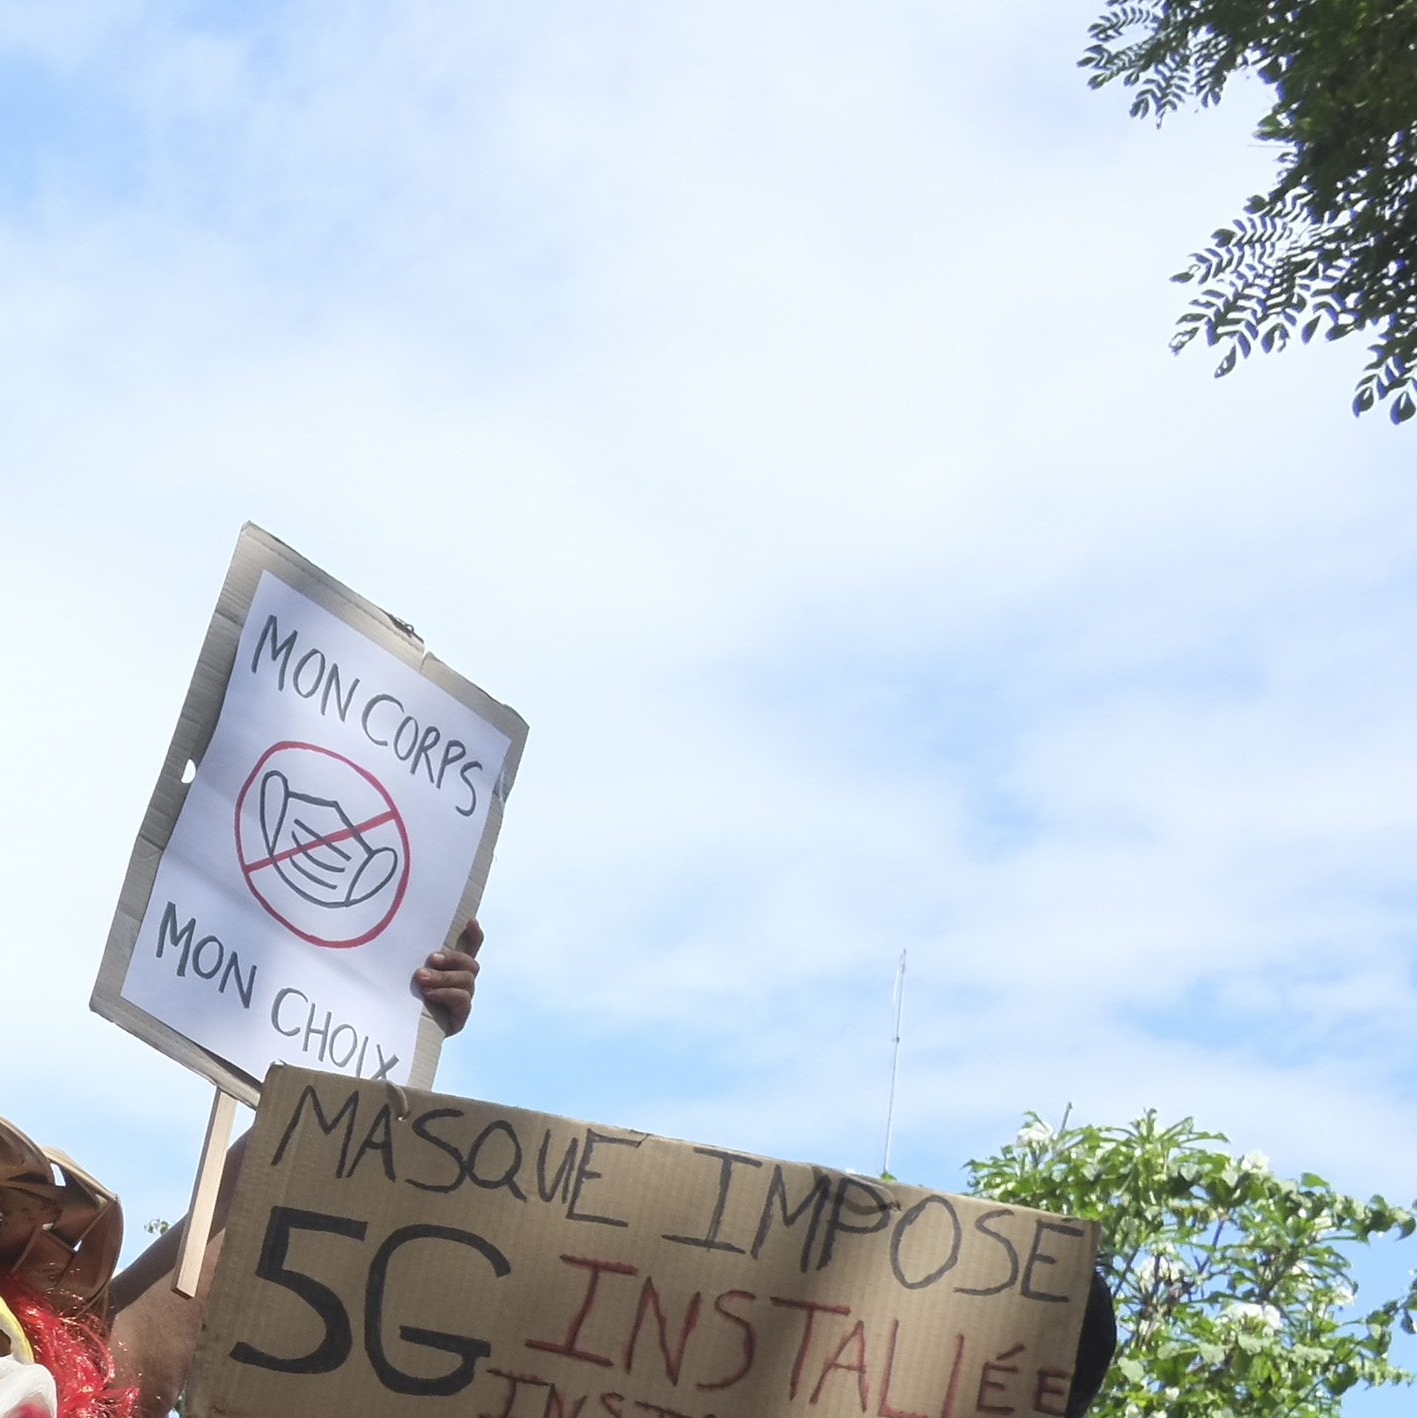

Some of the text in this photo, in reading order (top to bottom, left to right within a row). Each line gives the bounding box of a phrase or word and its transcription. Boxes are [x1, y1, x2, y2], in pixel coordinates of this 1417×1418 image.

[251, 615, 484, 817] MON CORPS
[155, 902, 401, 1082] MON CHOIX
[272, 1085, 647, 1229] MASQUE
[229, 1204, 513, 1398] 5G
